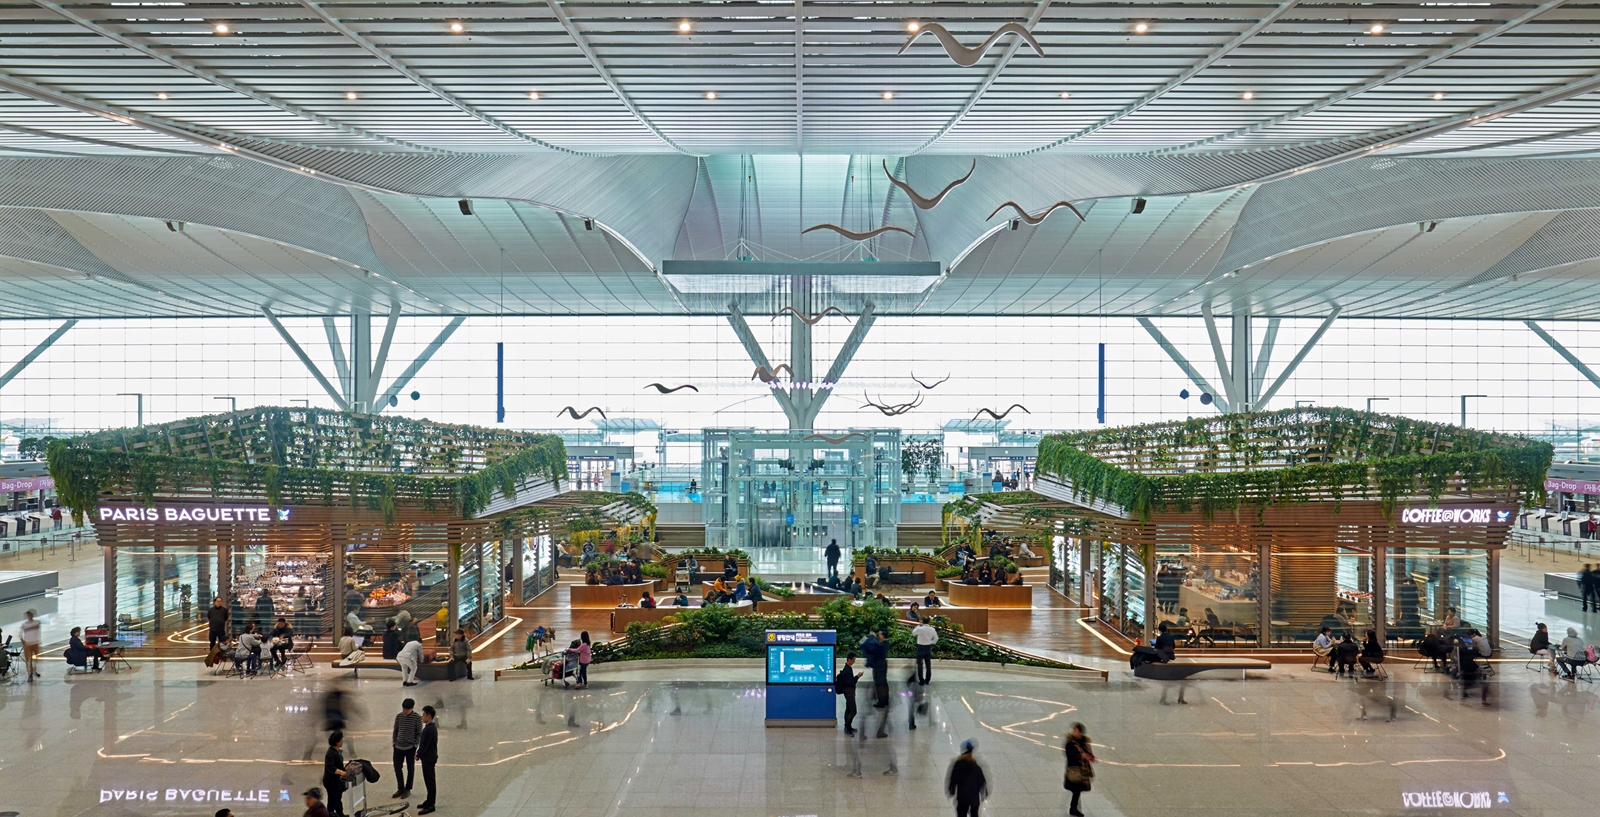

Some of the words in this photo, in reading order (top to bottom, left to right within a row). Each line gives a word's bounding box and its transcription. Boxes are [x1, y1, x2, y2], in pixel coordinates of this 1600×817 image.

[1, 481, 33, 491] Bag-Drop
[99, 507, 158, 521] PARIS
[164, 507, 271, 521] BAGUETTE
[1402, 508, 1492, 523] COFFEE@WORKS
